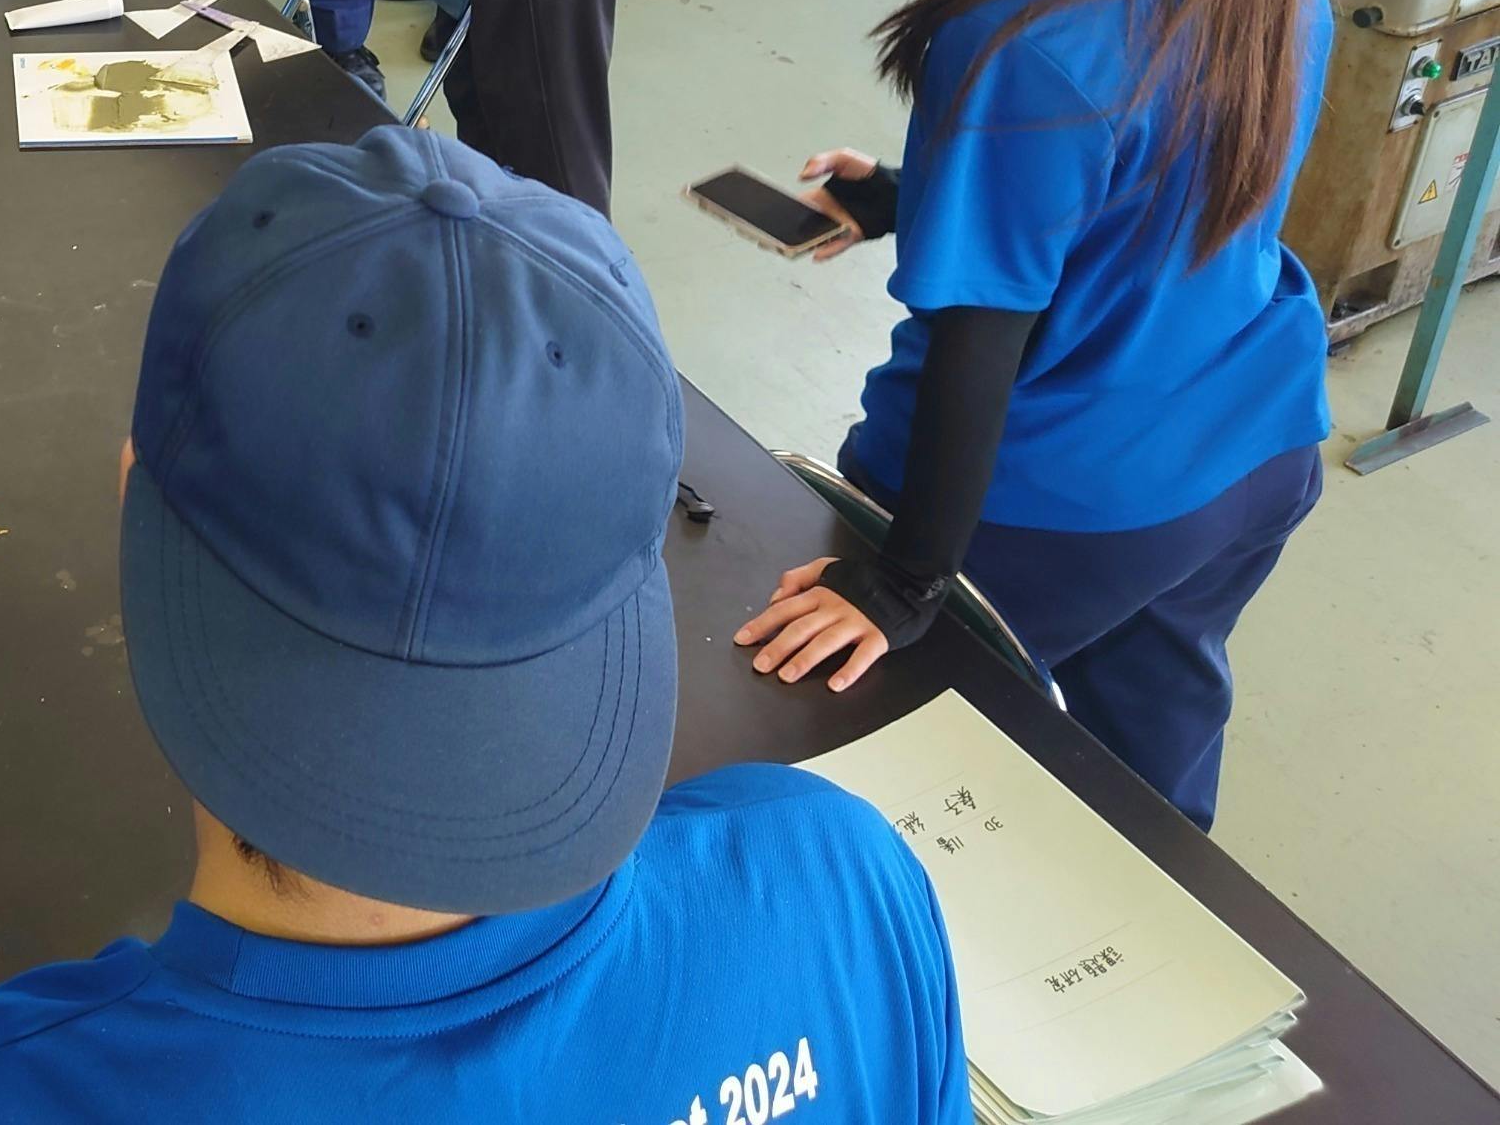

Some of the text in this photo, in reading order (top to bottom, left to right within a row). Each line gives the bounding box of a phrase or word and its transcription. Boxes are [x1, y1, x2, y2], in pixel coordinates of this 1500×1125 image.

[1044, 945, 1125, 994] 課題研究
[719, 1036, 818, 1125] 2024
